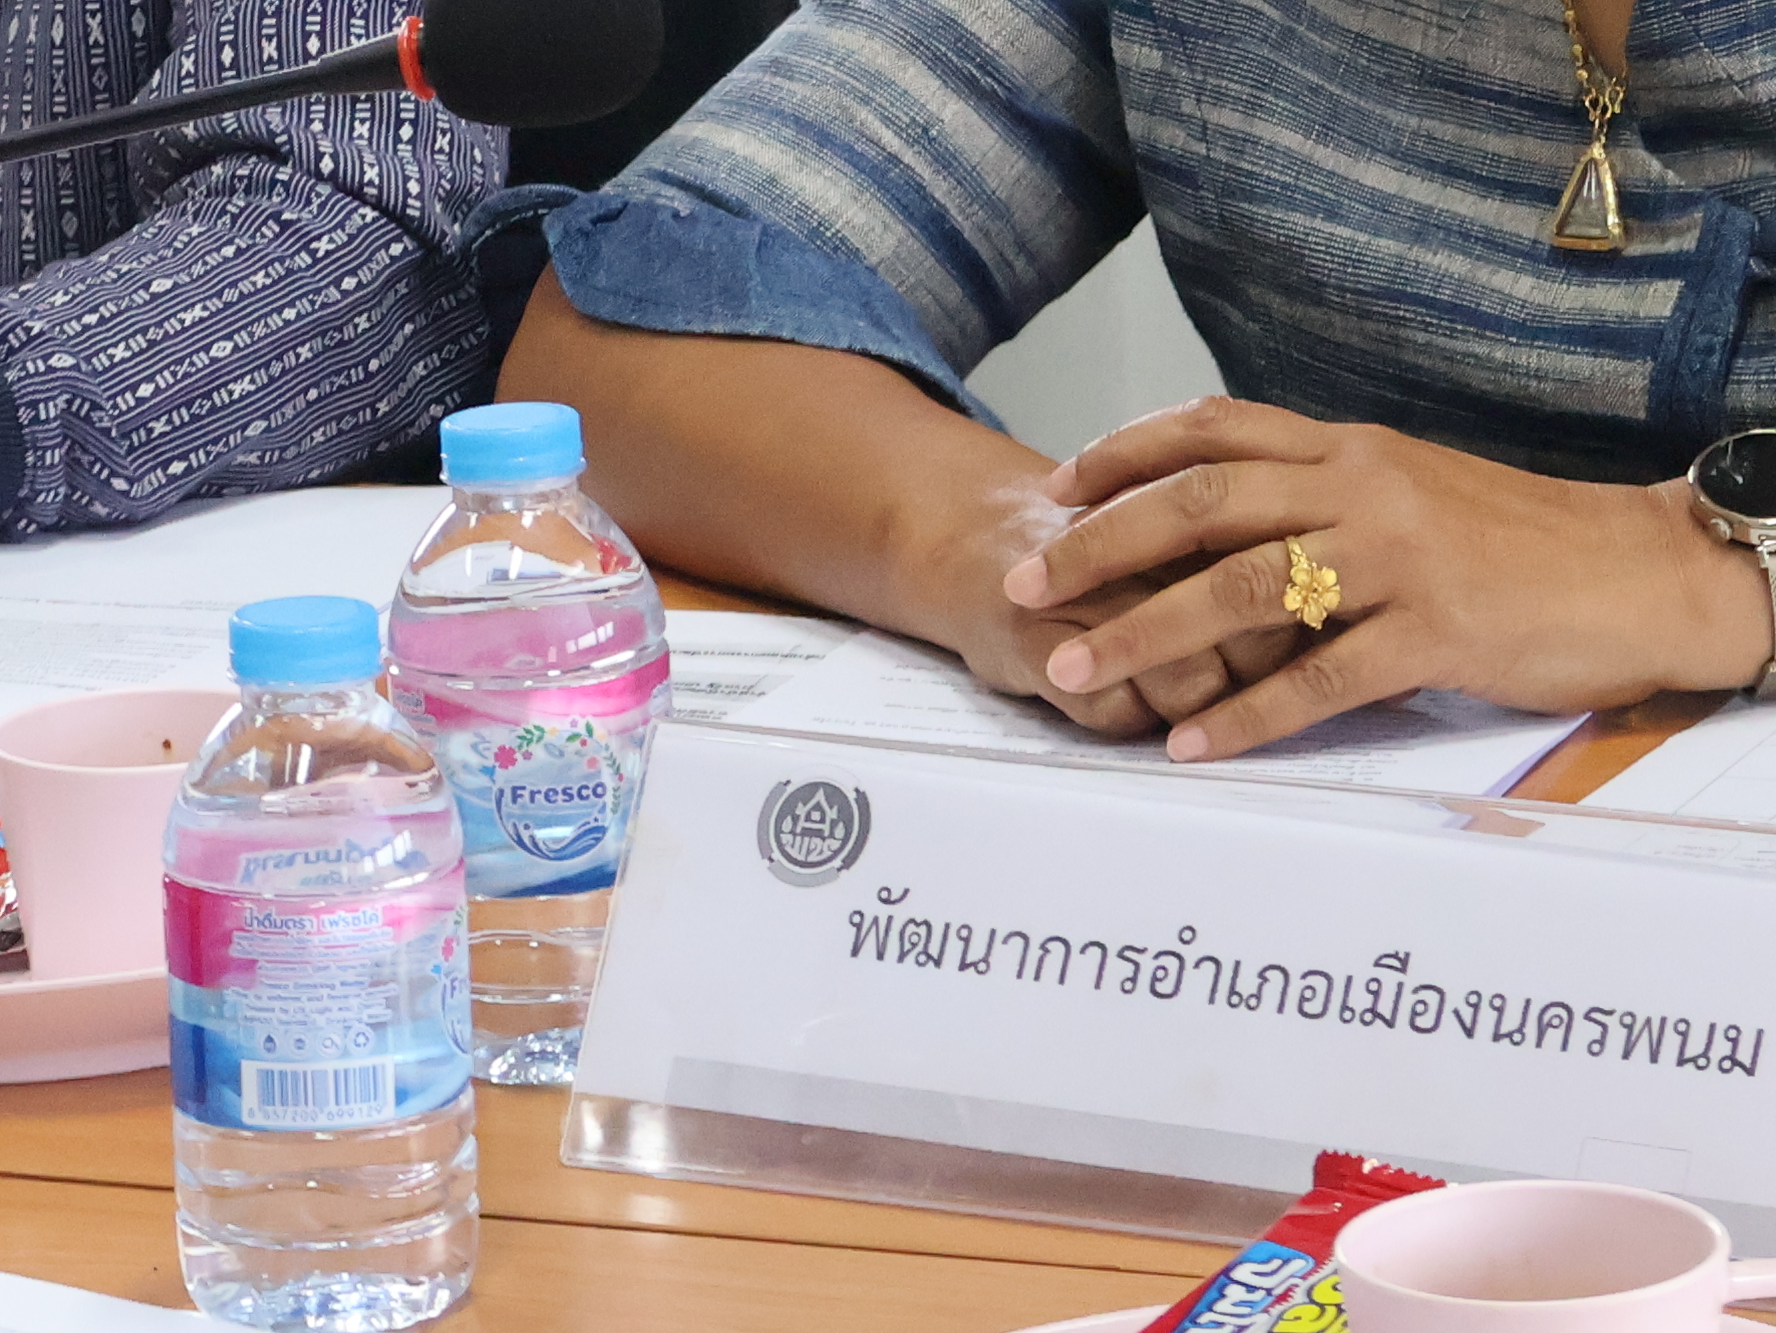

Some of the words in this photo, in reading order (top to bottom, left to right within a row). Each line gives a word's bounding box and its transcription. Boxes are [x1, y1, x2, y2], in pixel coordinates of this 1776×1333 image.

[510, 781, 608, 805] Fresco
[848, 886, 1765, 1079] พัฒนาการอำเภอเมืองนครพนม
